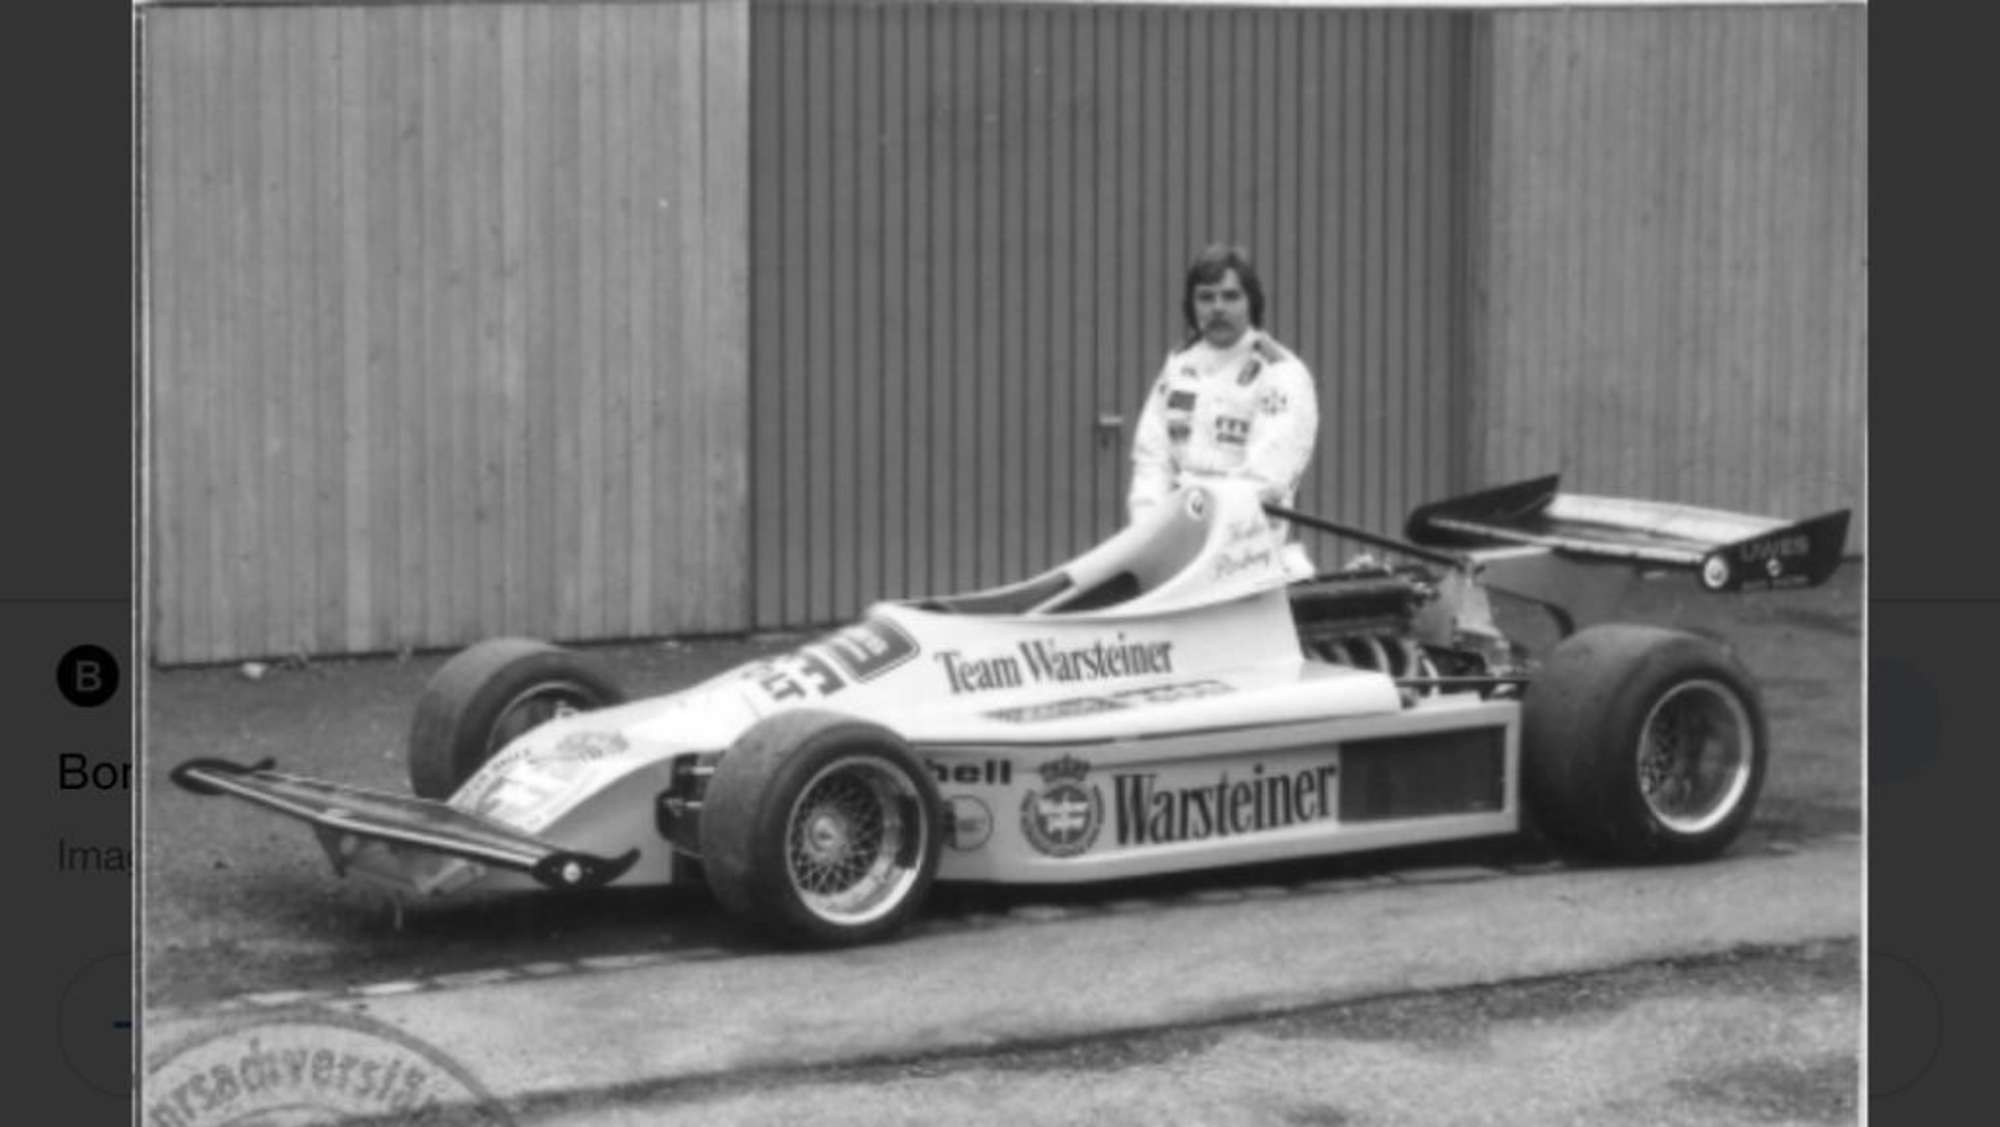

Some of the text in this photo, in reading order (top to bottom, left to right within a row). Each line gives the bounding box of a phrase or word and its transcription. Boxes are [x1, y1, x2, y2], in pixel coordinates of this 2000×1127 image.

[75, 662, 103, 690] B
[935, 649, 1020, 693] Team
[1020, 633, 1174, 683] Warsteiner
[1114, 763, 1337, 846] Warsteiner
